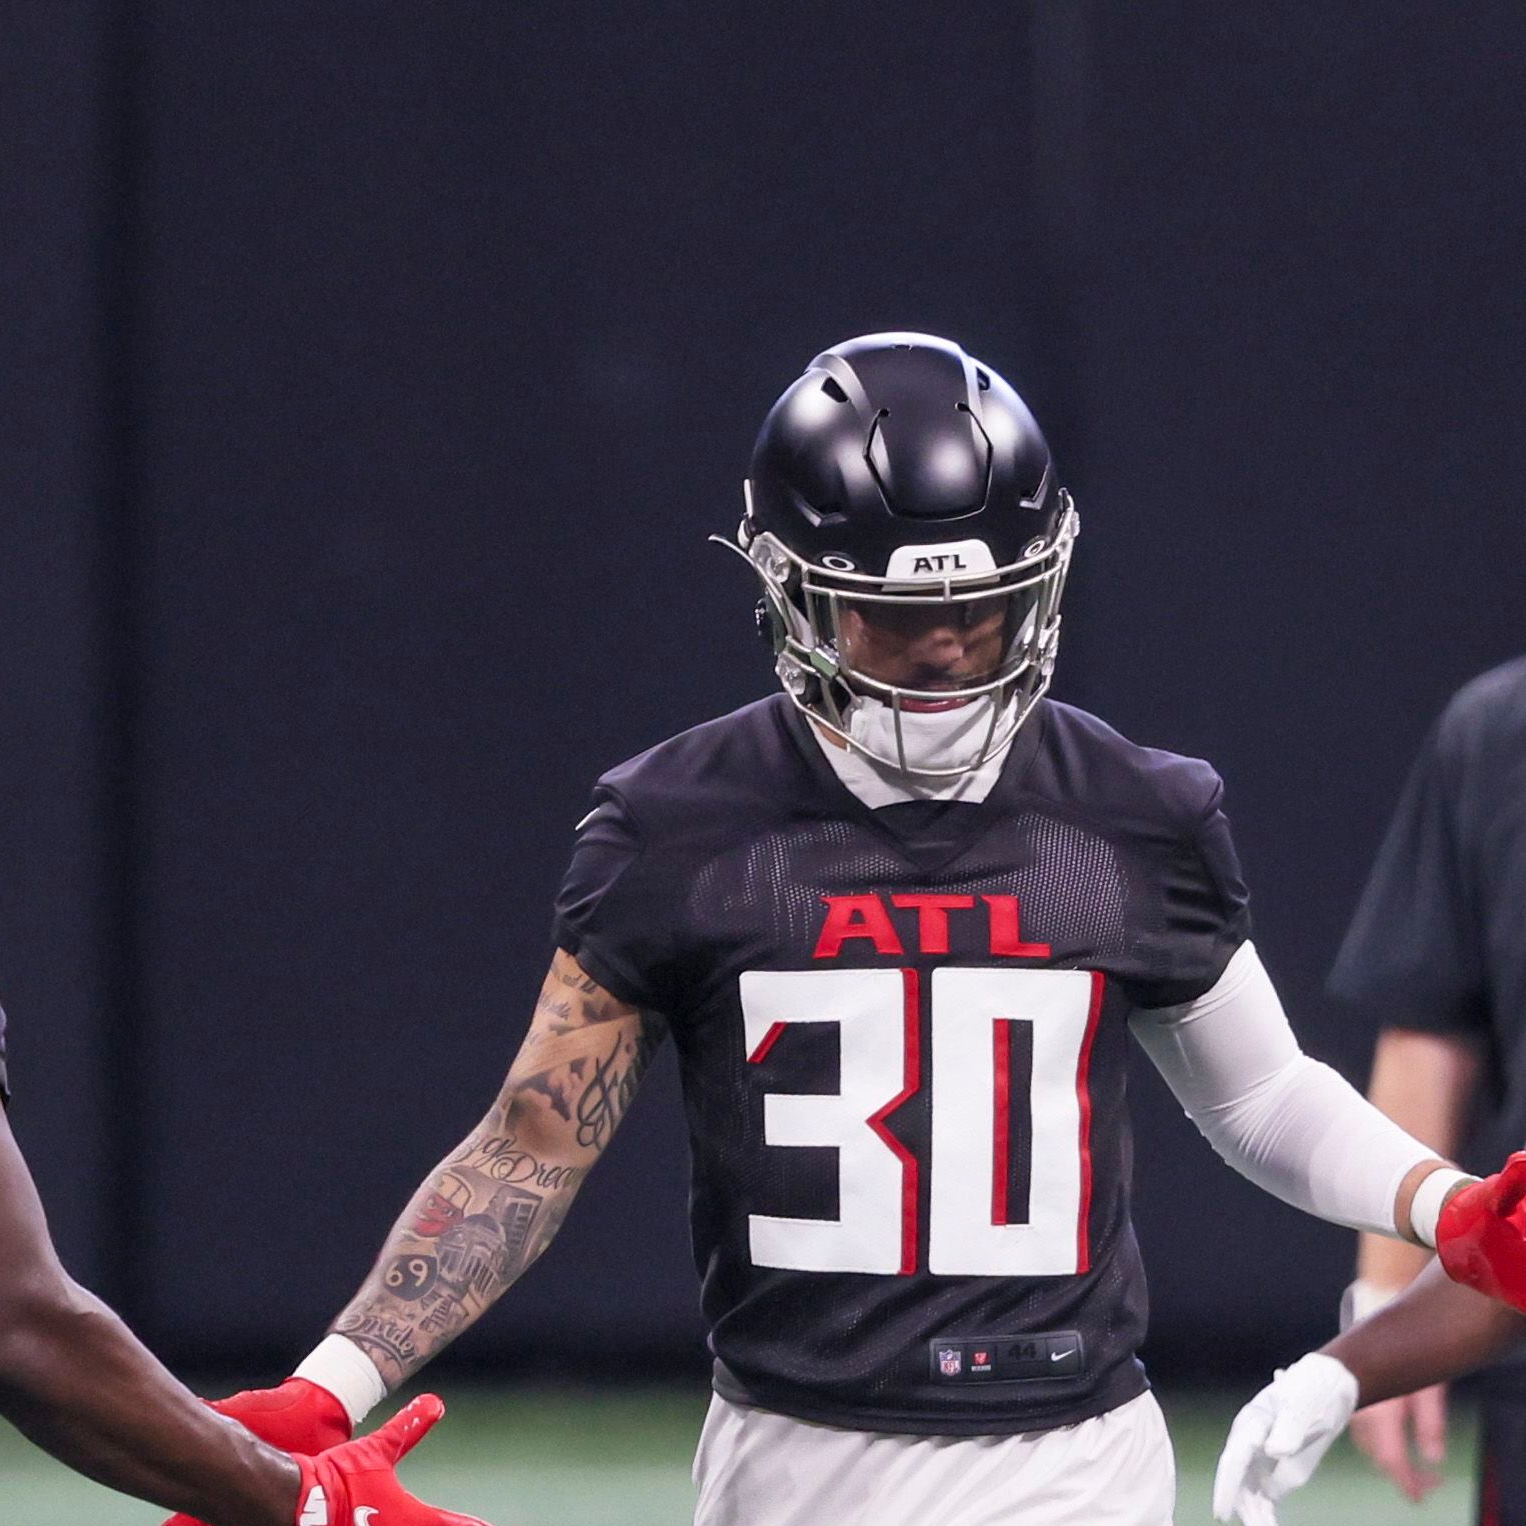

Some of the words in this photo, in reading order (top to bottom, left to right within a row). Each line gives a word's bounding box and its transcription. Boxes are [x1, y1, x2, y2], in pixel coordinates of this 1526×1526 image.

[913, 554, 967, 574] ATL
[813, 893, 1051, 959] ATL
[739, 967, 1106, 1276] 30
